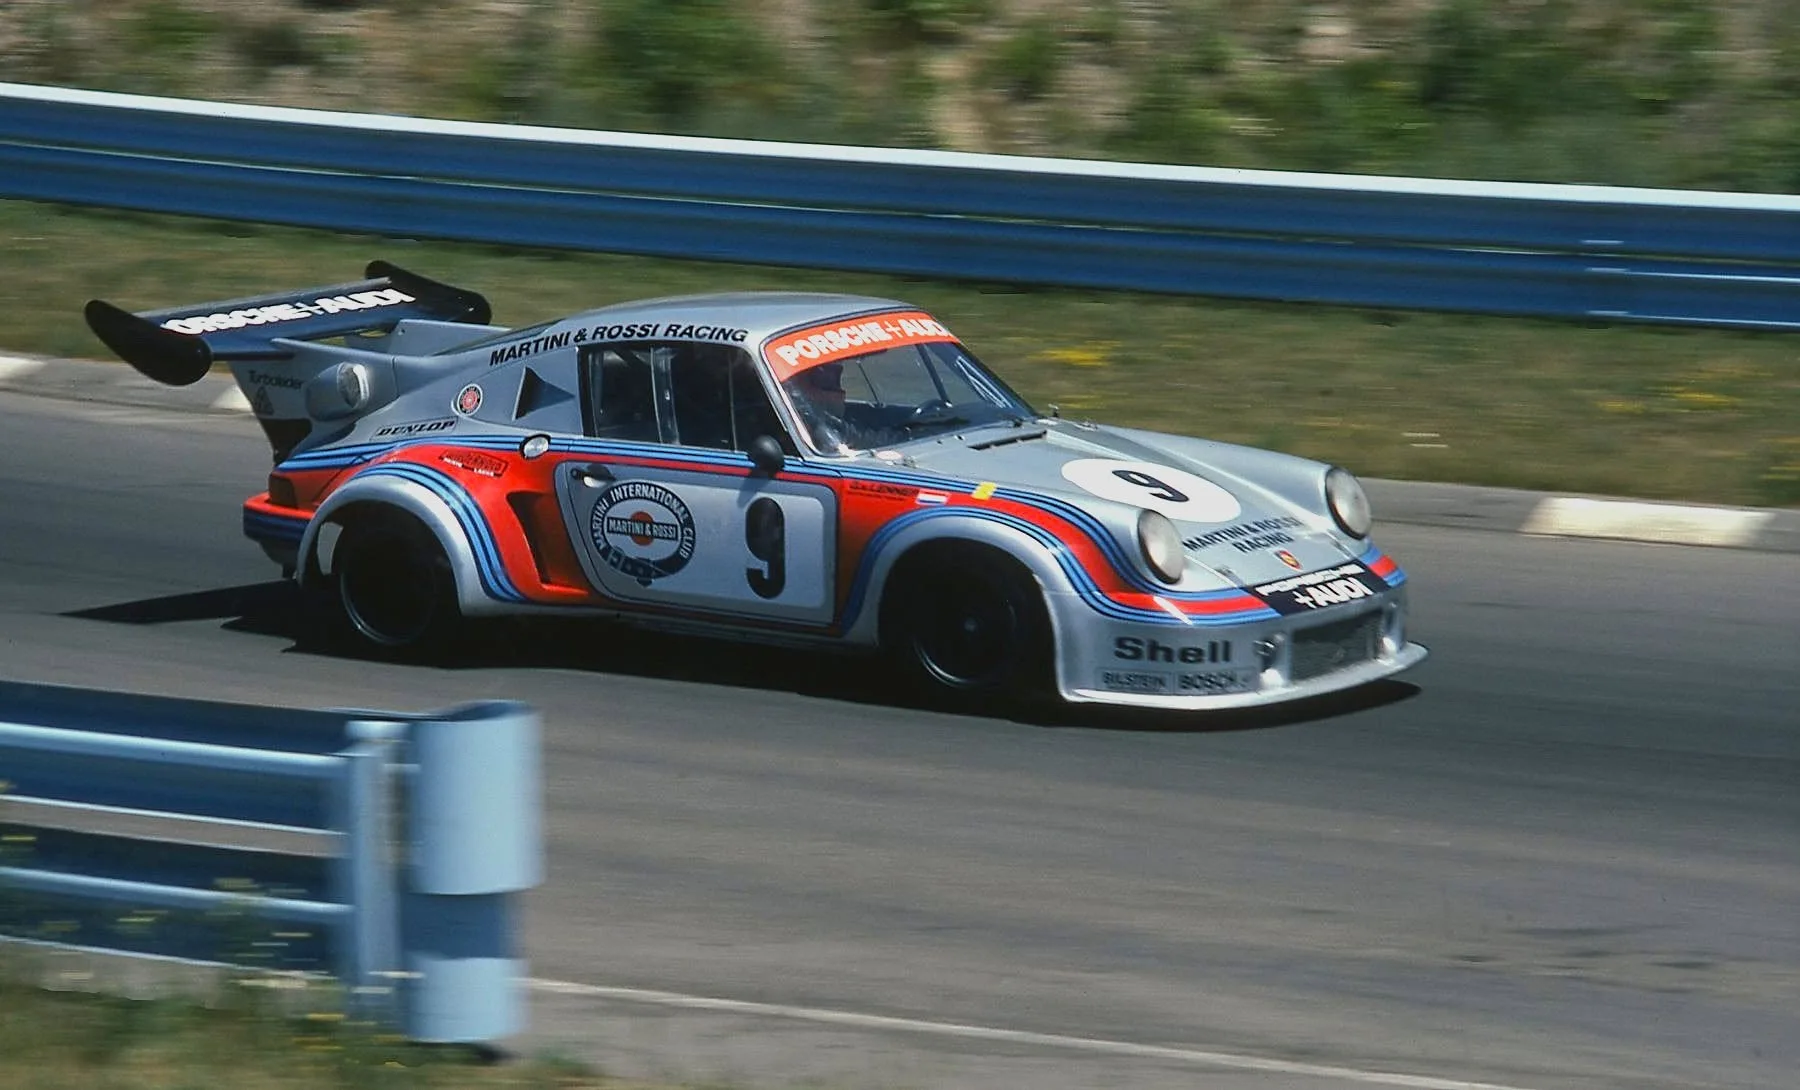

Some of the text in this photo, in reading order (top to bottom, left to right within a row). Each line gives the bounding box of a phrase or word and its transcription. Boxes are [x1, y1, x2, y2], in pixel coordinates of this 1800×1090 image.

[160, 288, 416, 335] ORSCHE+AUDI
[489, 323, 749, 366] MARTINI & ROSSI RACING
[775, 318, 957, 367] PORSCHE+AUD
[377, 420, 455, 436] DUNLOP
[1112, 469, 1190, 503] 9
[608, 519, 677, 539] MARTINI & ROSSI
[609, 483, 690, 524] INTERNATIONAL
[679, 527, 694, 559] CLUB
[745, 497, 786, 599] 9
[1231, 532, 1295, 553] RACING
[1114, 636, 1231, 663] Shell
